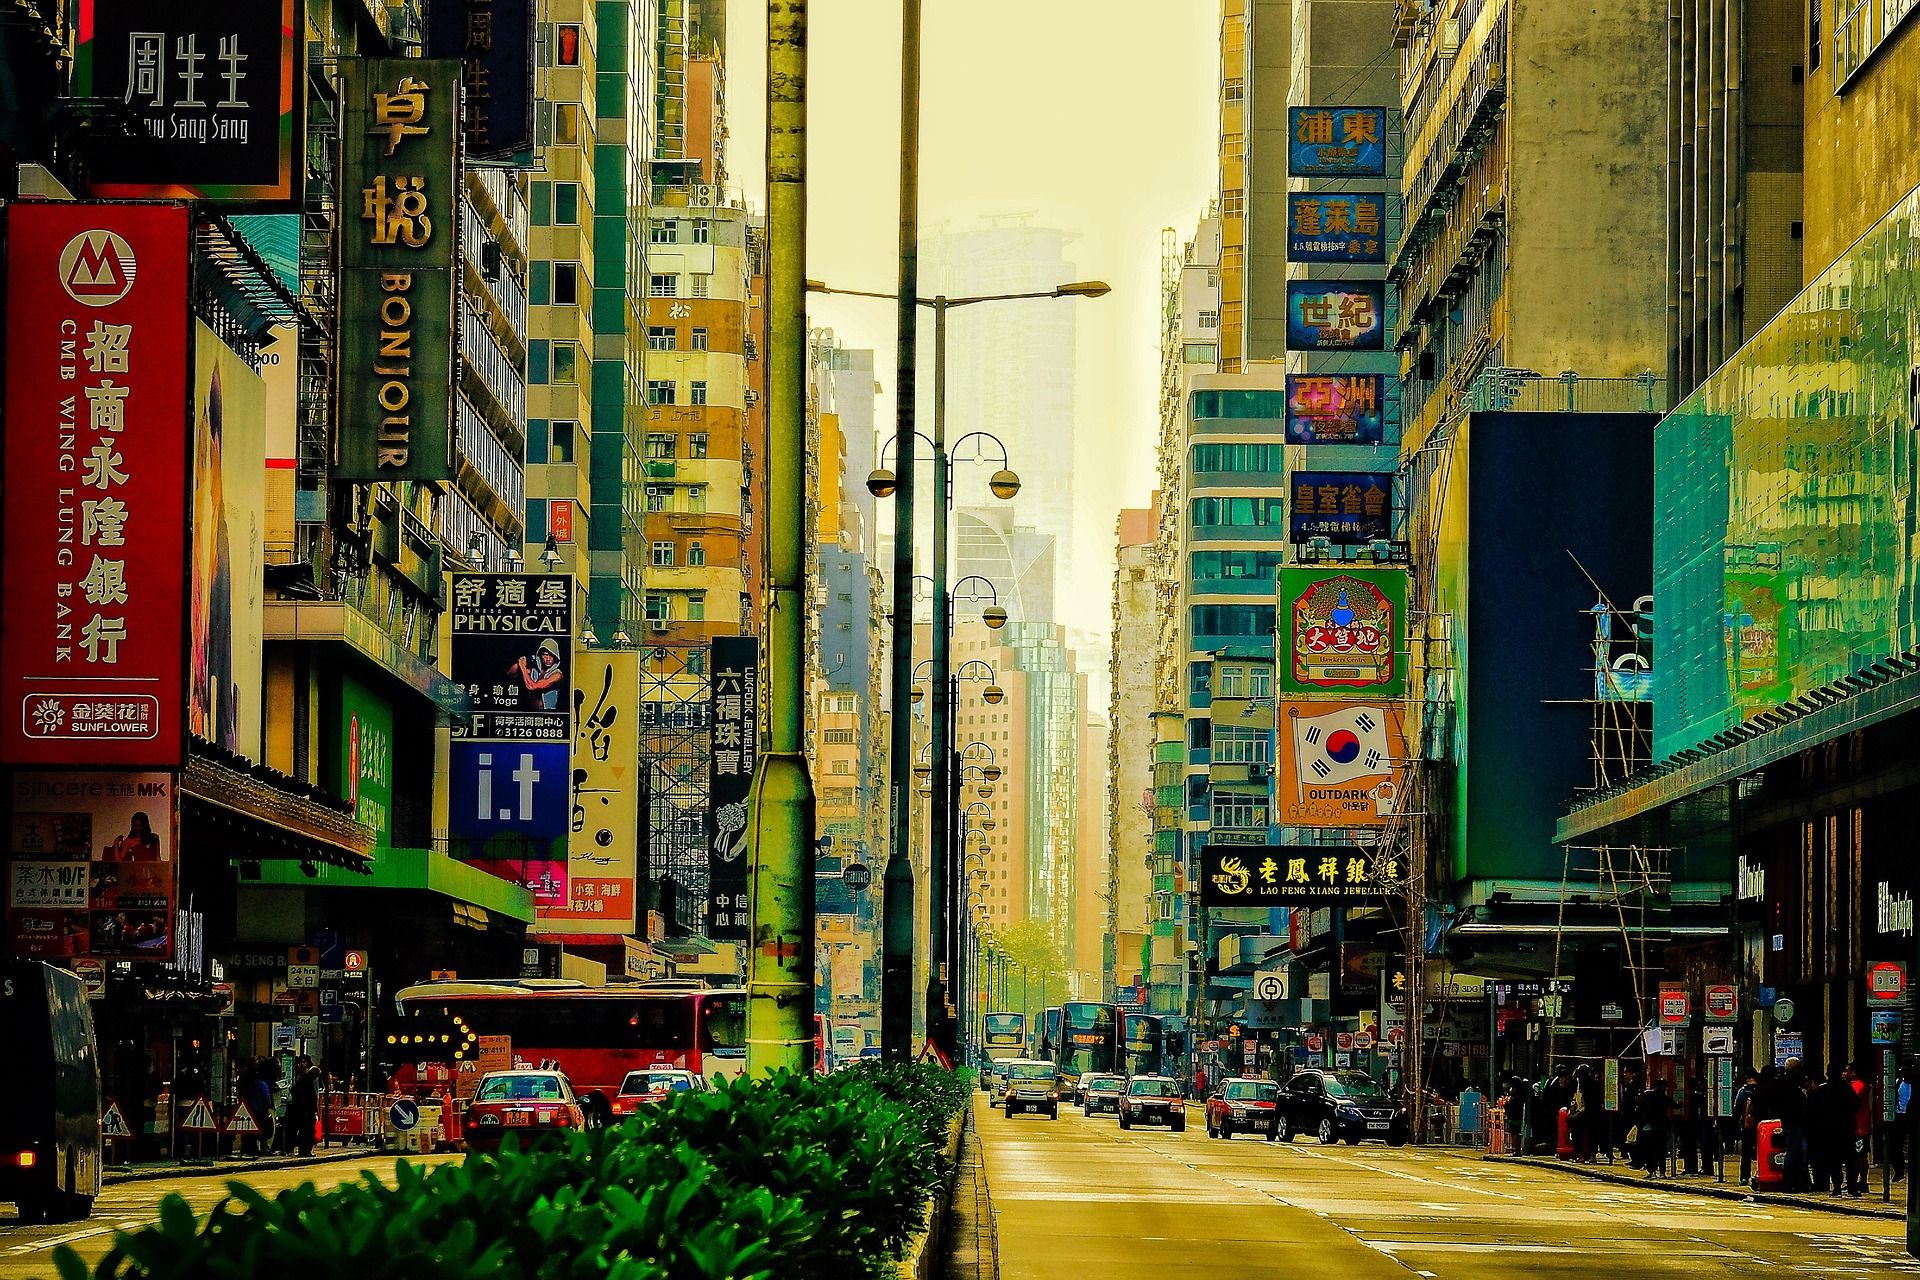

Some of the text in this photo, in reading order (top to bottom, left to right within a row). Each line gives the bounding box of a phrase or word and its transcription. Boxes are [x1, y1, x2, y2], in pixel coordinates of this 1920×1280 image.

[124, 31, 250, 108] 周生生
[170, 112, 207, 144] Sang
[211, 112, 249, 145] Sang
[1296, 111, 1379, 144] 浦東
[1300, 294, 1373, 328] 世紀
[374, 271, 413, 468] BONJOUR
[1294, 375, 1376, 418] 亞洲
[56, 318, 77, 663] CMB WING LUNG BANK
[79, 319, 133, 664] 招商永隆銀行
[1294, 483, 1387, 517] 皇室雀會
[454, 577, 567, 608] 舒適堡
[454, 613, 567, 632] PHYSICAL
[493, 696, 518, 707] Yoga
[72, 703, 137, 720] 金葵花
[715, 666, 741, 775] 六福珠寶
[743, 666, 754, 775] LUKFOOK JEWELLERY
[72, 722, 149, 732] SUNFLOWER
[504, 729, 563, 738] 3126 0888
[17, 782, 104, 796] sincere
[137, 783, 167, 797] MK
[477, 752, 540, 821] i.t
[1309, 789, 1368, 800] OUTDARK
[57, 866, 86, 886] 10/F
[575, 883, 594, 896] 小菜
[1260, 886, 1278, 895] LAO
[1282, 886, 1305, 895] FENG
[1309, 886, 1340, 895] XIANG
[244, 953, 274, 966] SENG
[290, 967, 302, 975] 24
[303, 967, 316, 975] hrs
[1877, 976, 1899, 984] 9 95
[293, 977, 313, 986] 全日
[1390, 994, 1404, 1002] LAO
